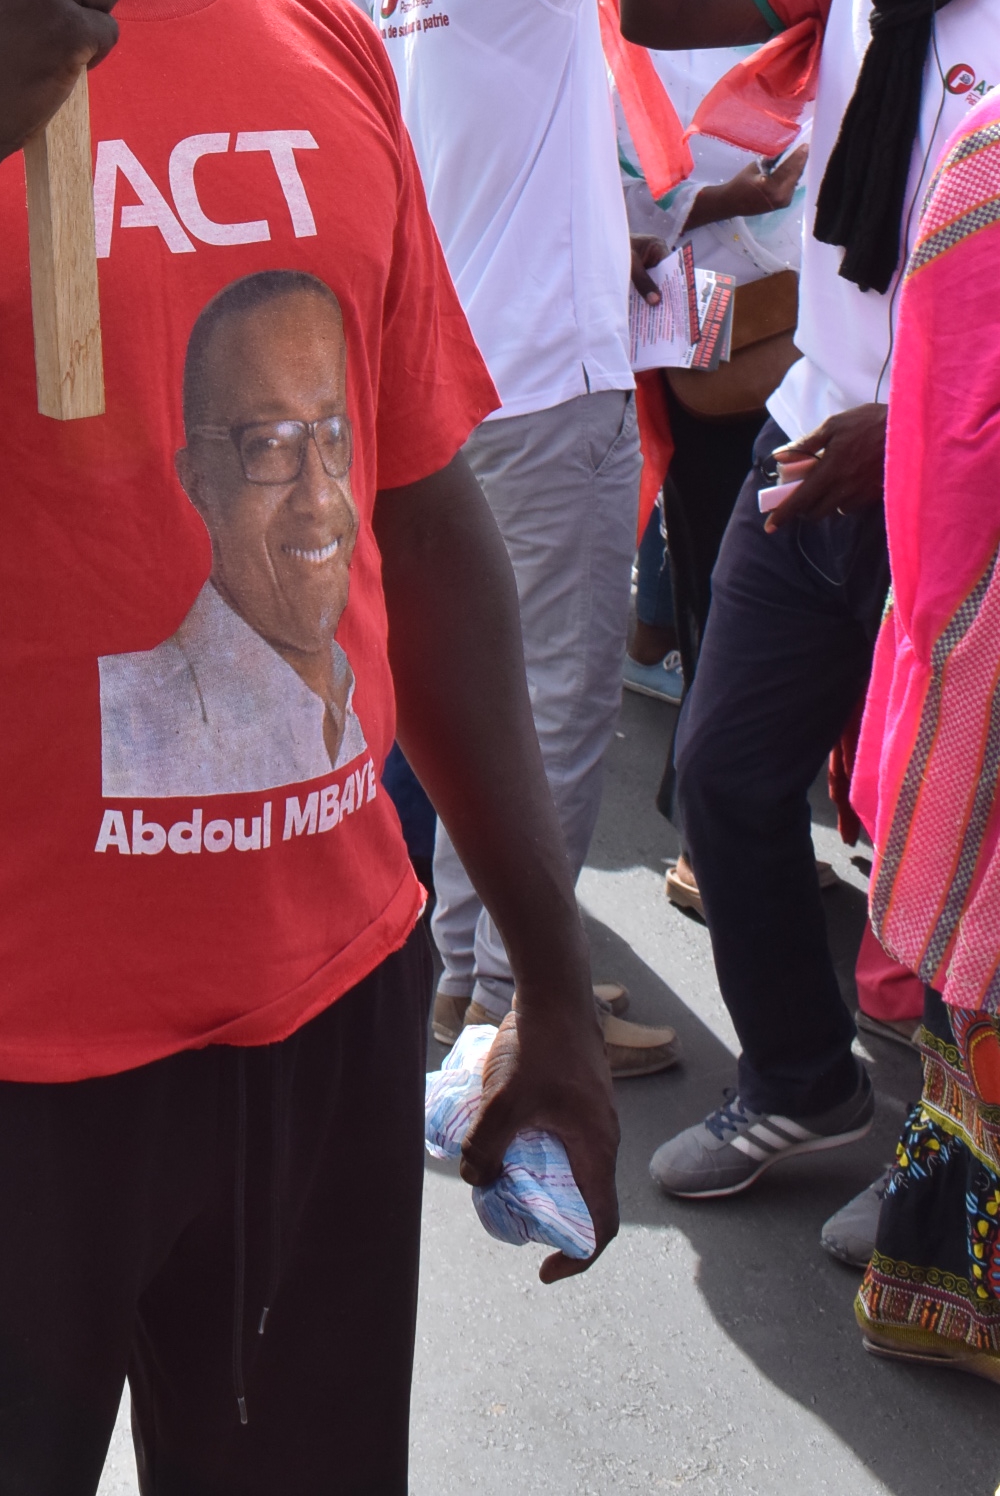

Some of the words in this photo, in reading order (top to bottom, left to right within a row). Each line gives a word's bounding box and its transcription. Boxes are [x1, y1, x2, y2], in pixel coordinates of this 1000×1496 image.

[387, 24, 398, 39] de
[423, 12, 450, 33] patrie
[95, 128, 320, 259] ACT
[95, 801, 273, 856] Abdoul
